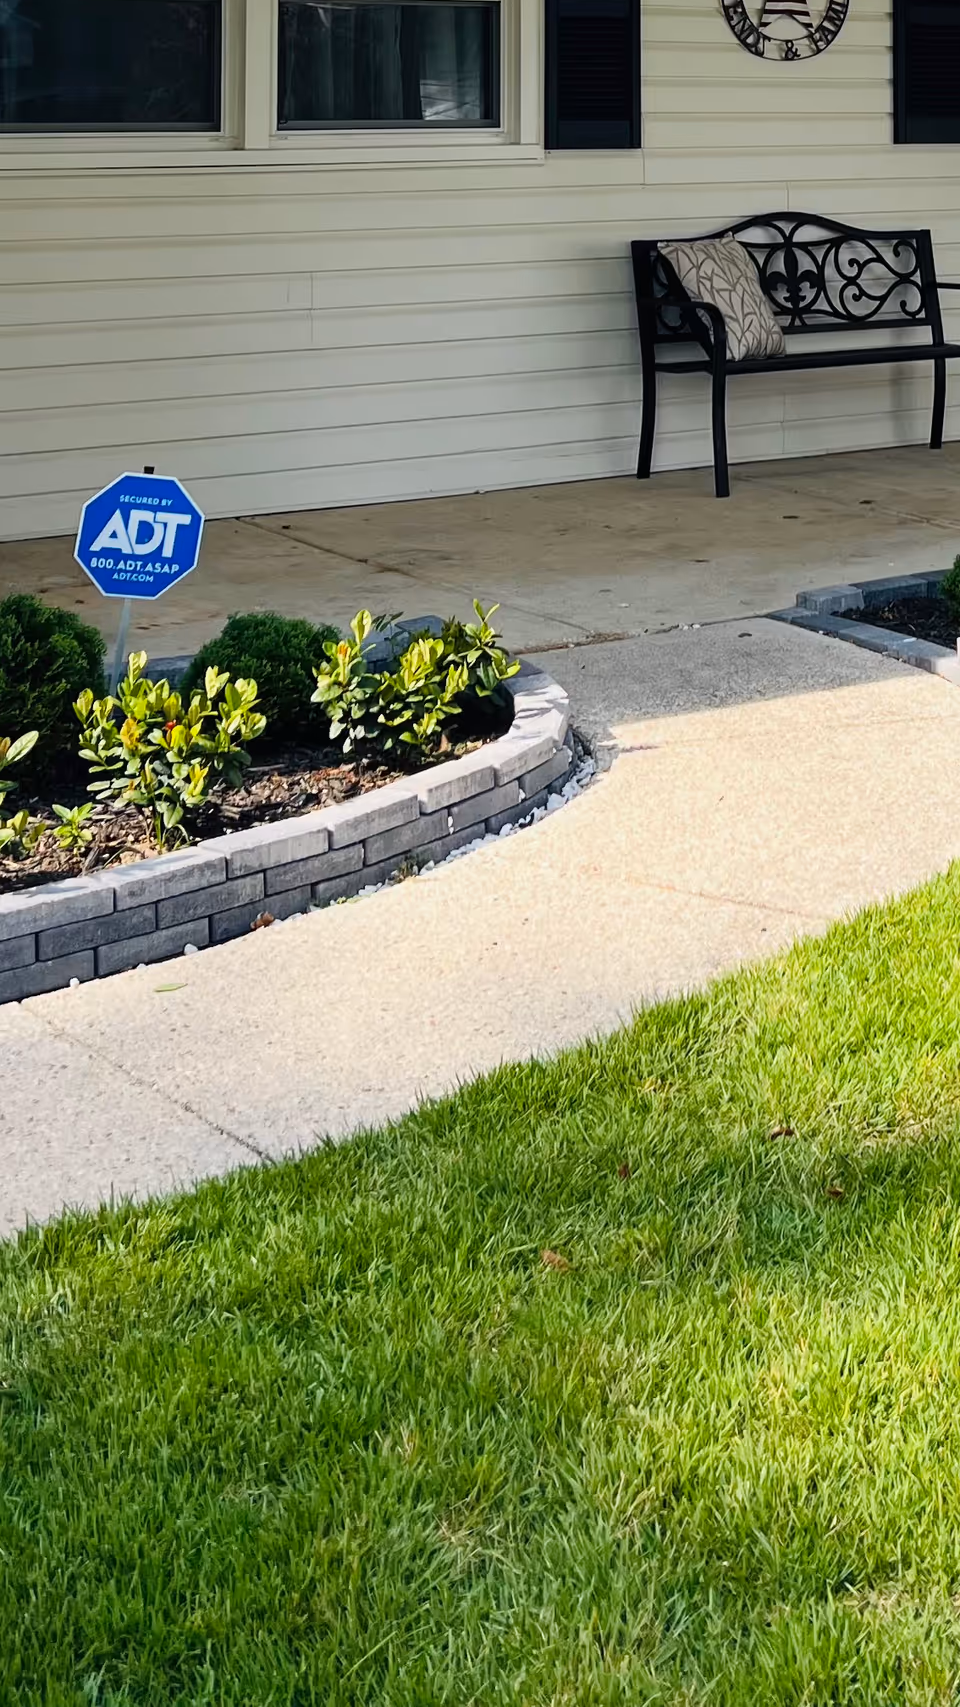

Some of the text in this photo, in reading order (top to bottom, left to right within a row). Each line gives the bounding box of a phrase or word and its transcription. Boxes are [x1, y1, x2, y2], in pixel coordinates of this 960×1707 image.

[783, 39, 801, 60] &
[119, 494, 158, 506] SECURED
[89, 508, 192, 558] ADT
[90, 558, 180, 575] 800.ADT.ASAP
[112, 572, 154, 583] ADT.COM
